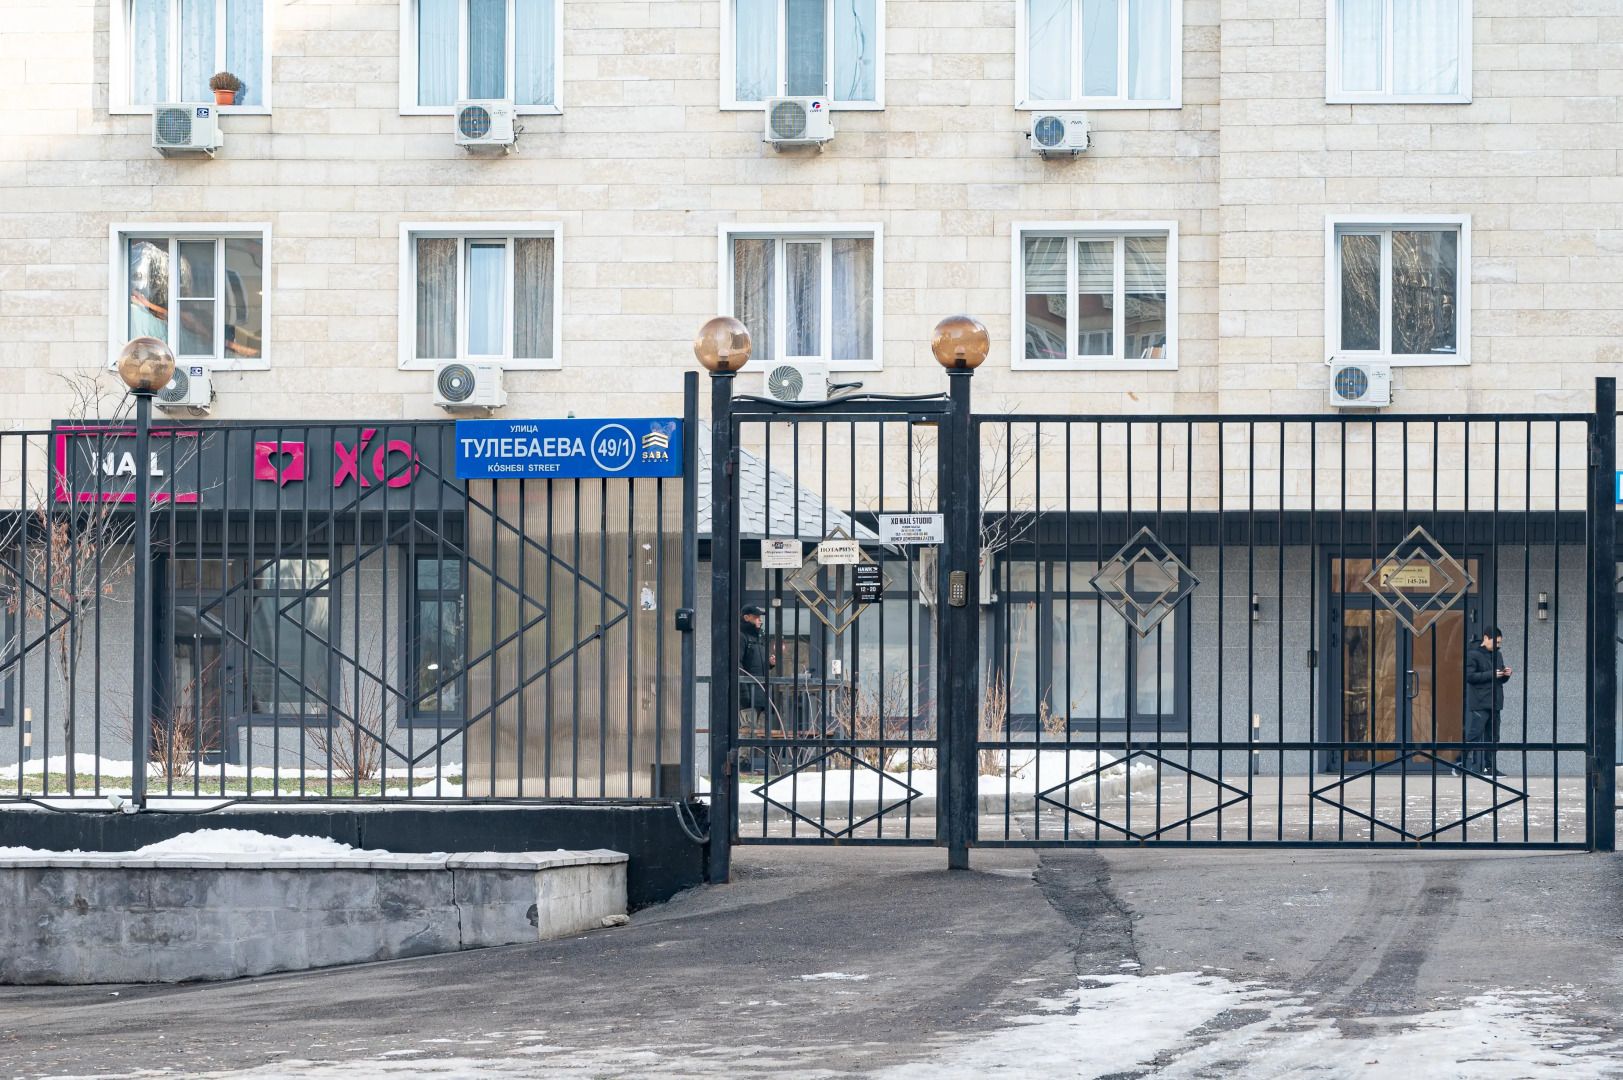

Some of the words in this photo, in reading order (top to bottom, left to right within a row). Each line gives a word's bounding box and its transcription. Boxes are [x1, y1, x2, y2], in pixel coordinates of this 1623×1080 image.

[510, 425, 538, 433] УЛИЦА
[461, 437, 586, 458] ТУЛЕБАЕВА
[598, 438, 629, 457] 49/1
[642, 451, 669, 459] SABA
[91, 451, 164, 476] NAL
[528, 463, 560, 472] STREET
[899, 517, 911, 525] NAIL
[912, 516, 932, 524] STUDIO
